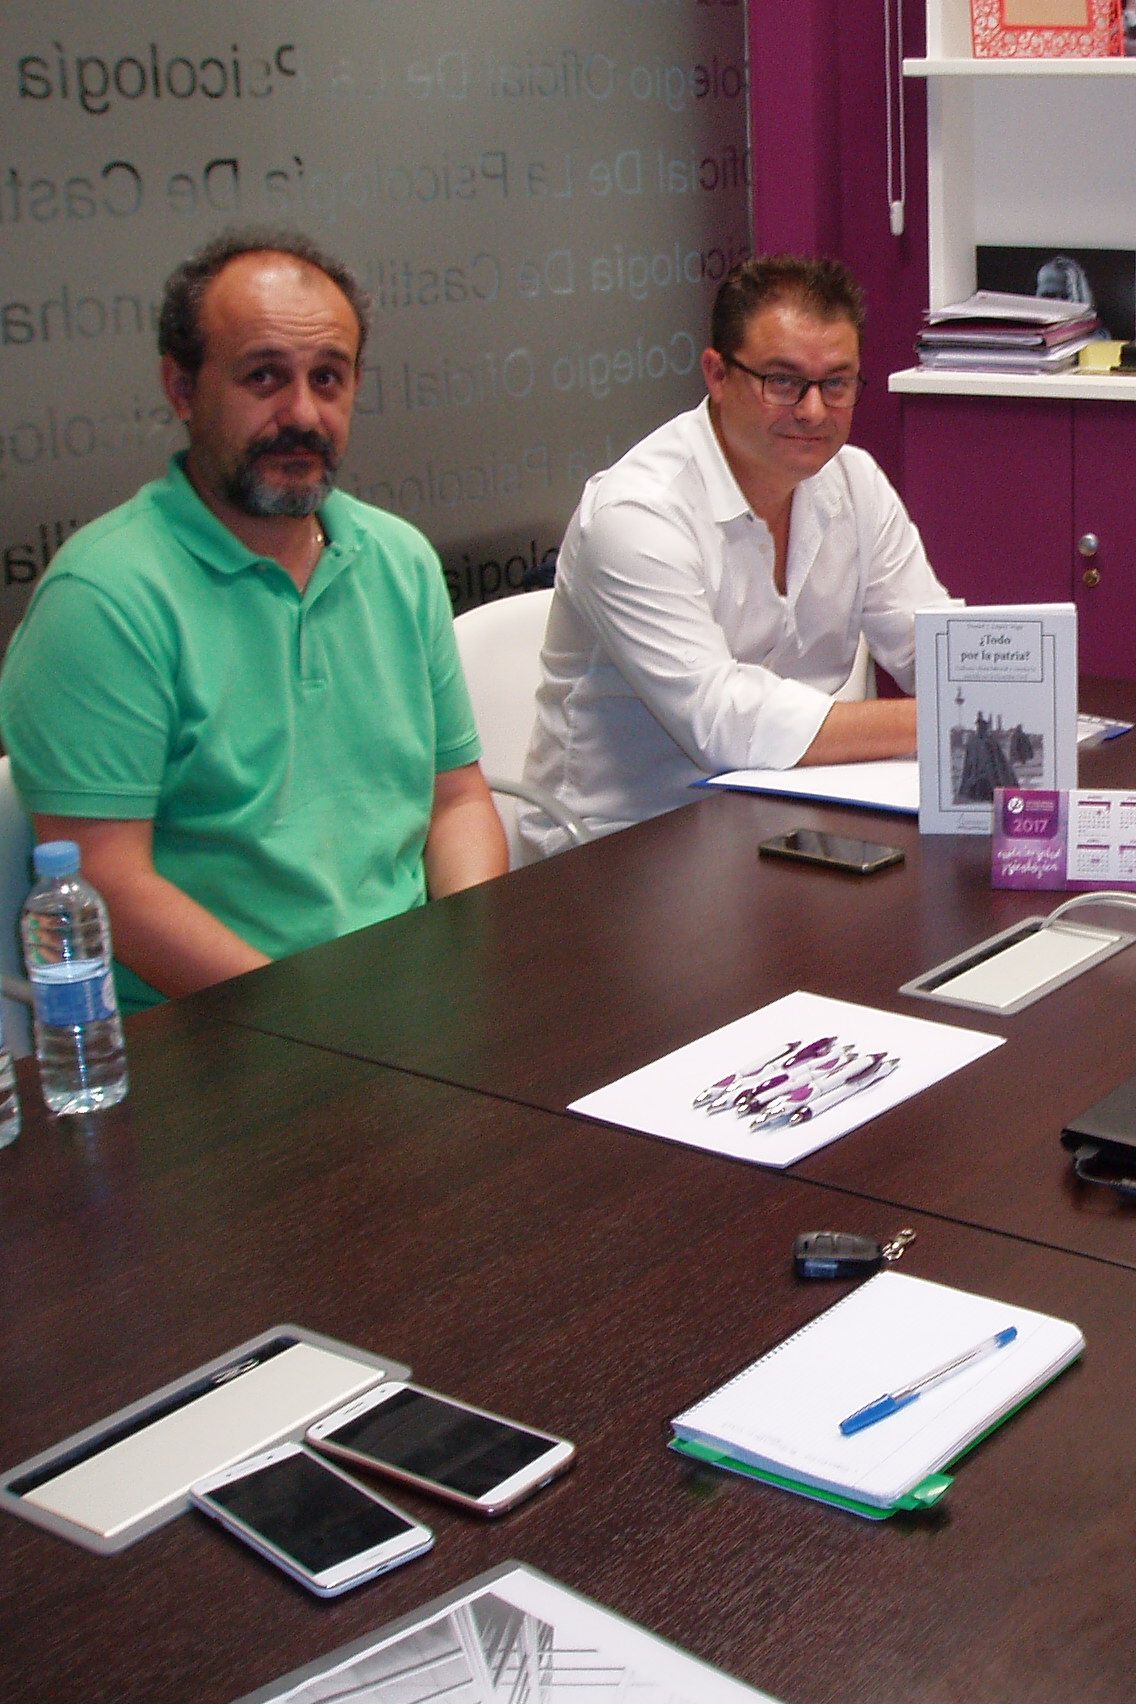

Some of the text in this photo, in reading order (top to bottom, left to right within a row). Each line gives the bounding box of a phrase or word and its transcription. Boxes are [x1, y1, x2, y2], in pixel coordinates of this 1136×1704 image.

[979, 633, 1011, 647] ¿Todo
[961, 649, 1031, 664] por la patria?
[1013, 818, 1049, 833] 2017
